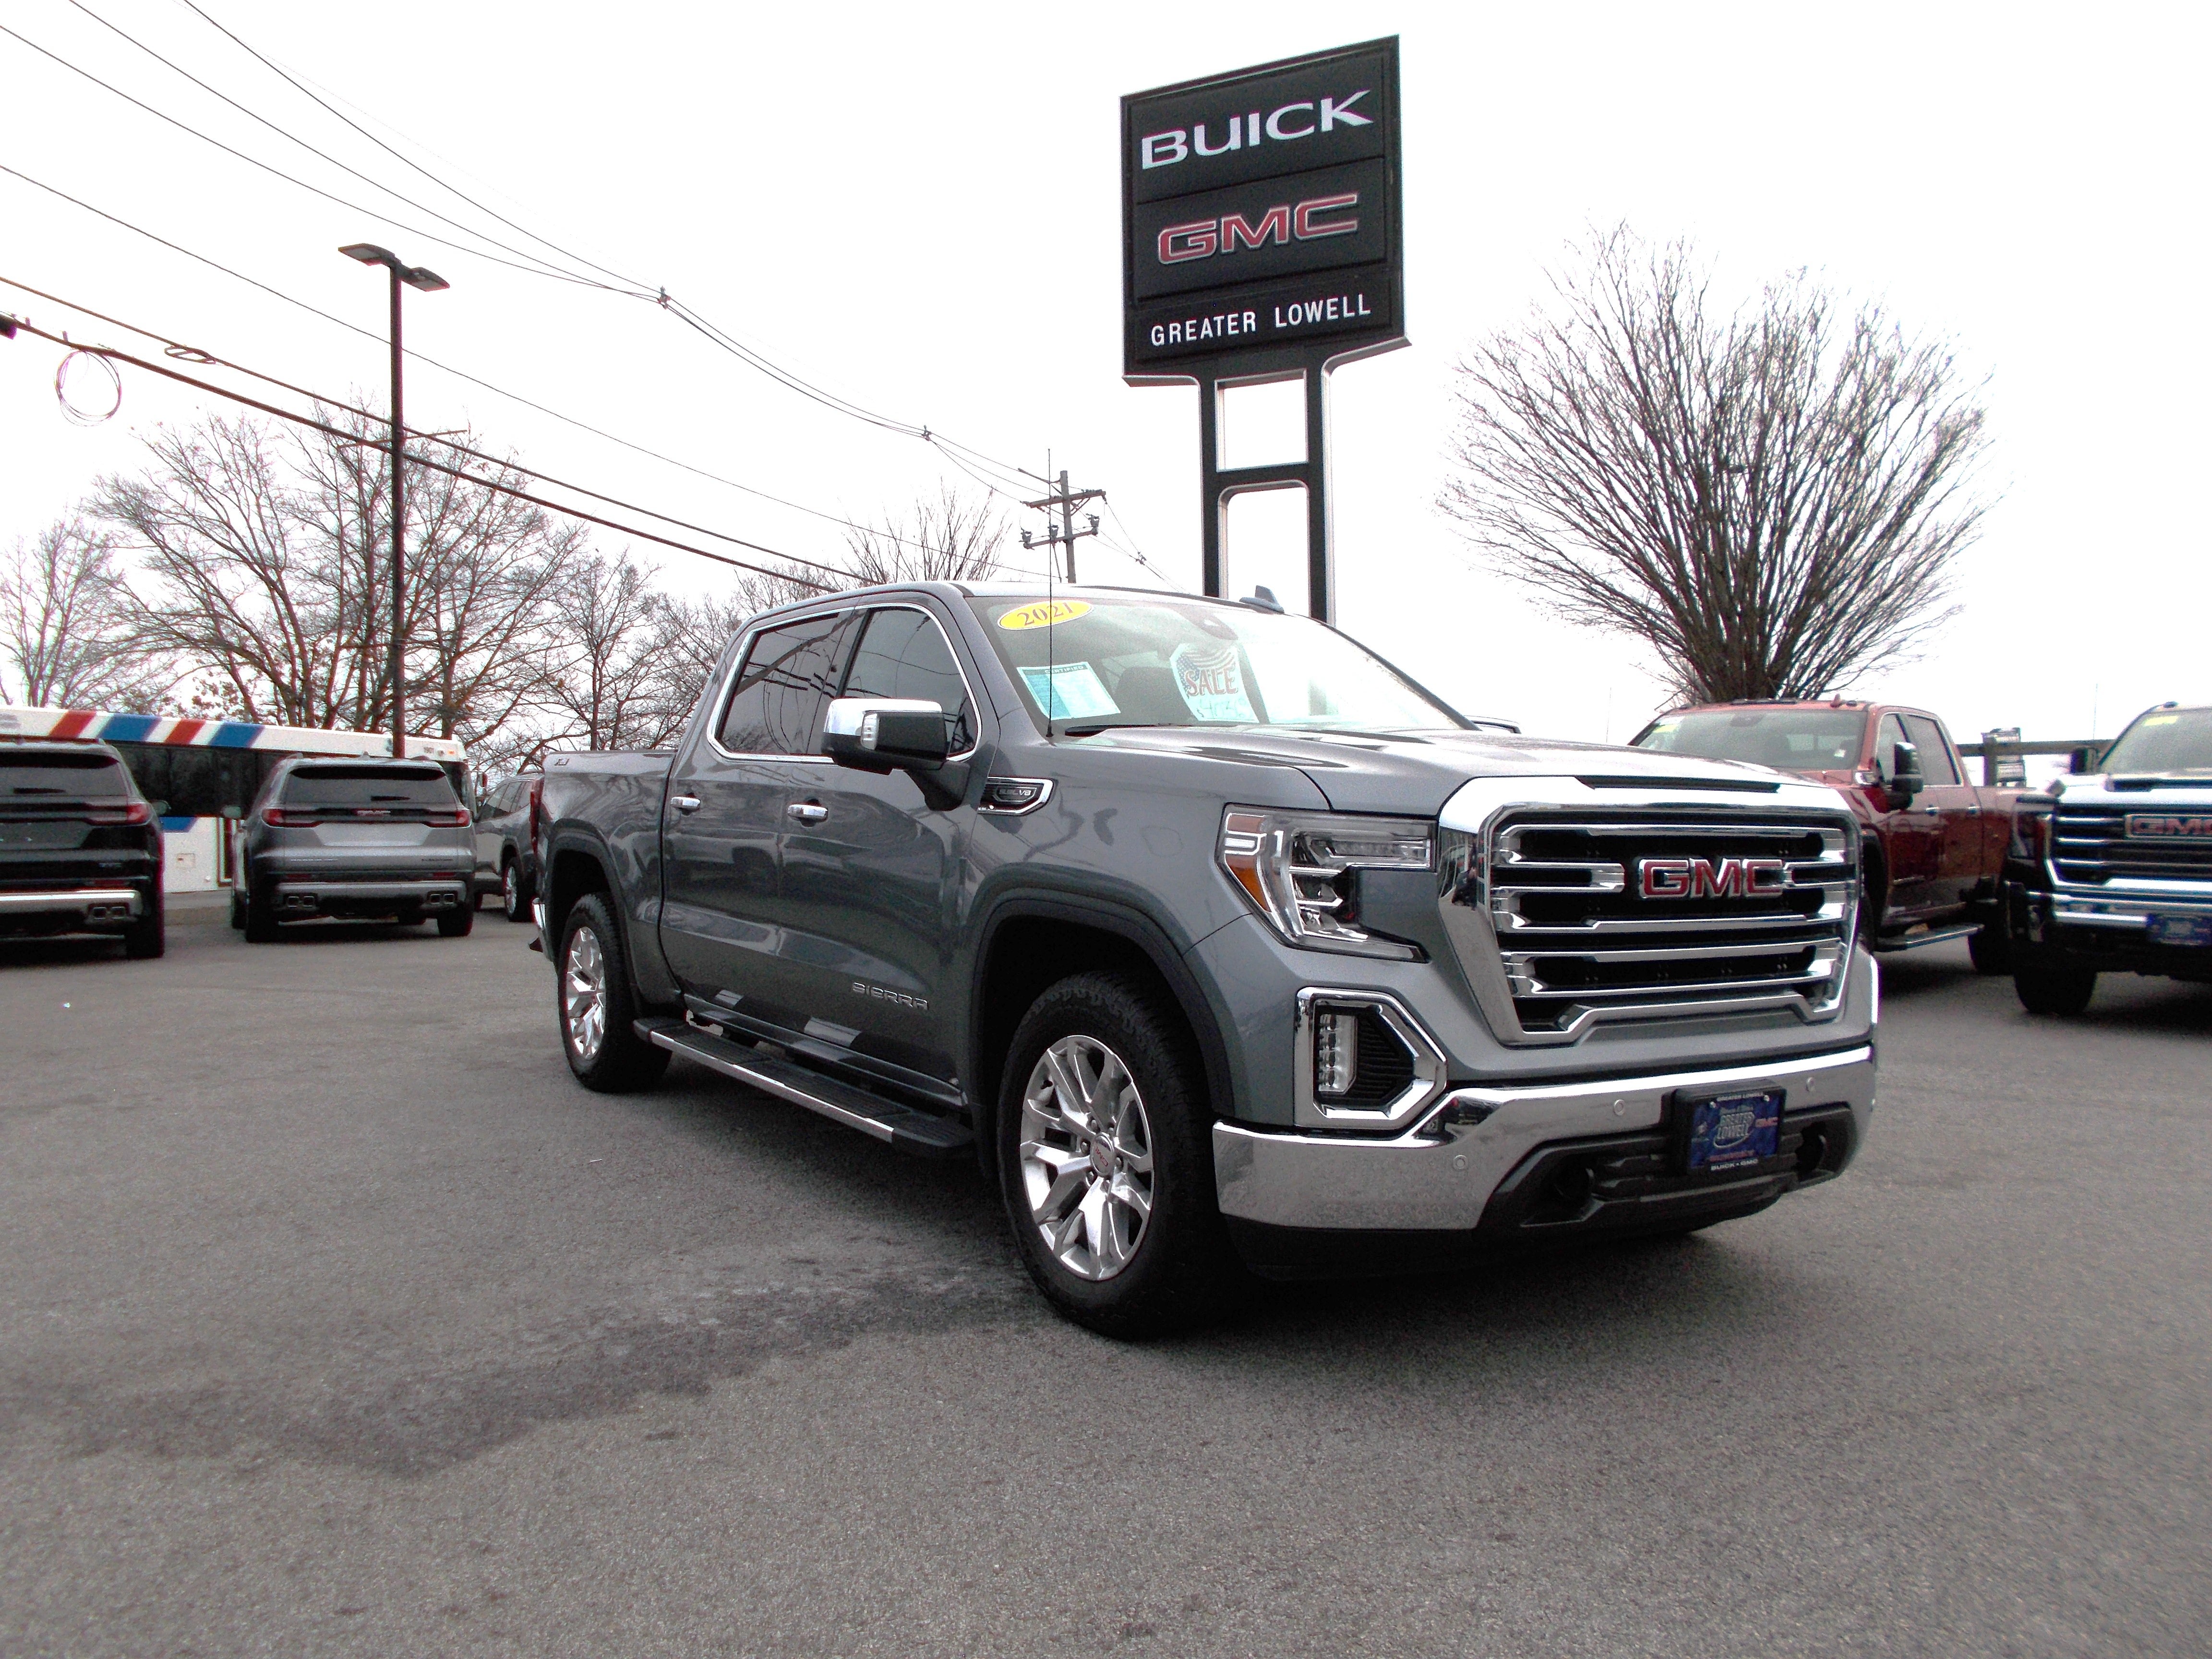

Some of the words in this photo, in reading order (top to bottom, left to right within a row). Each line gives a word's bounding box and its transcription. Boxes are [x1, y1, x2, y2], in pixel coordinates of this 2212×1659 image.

[1142, 90, 1374, 169] BUICK
[1158, 192, 1361, 264] GMC
[1151, 312, 1256, 347] GREATER
[1275, 294, 1371, 328] LOWELL
[1017, 602, 1073, 626] 2021
[1185, 662, 1238, 697] SALE
[2133, 818, 2212, 834] GM
[1639, 858, 1783, 899] GMC
[853, 982, 929, 1010] SIERRA
[1710, 1162, 1735, 1171] BUICK
